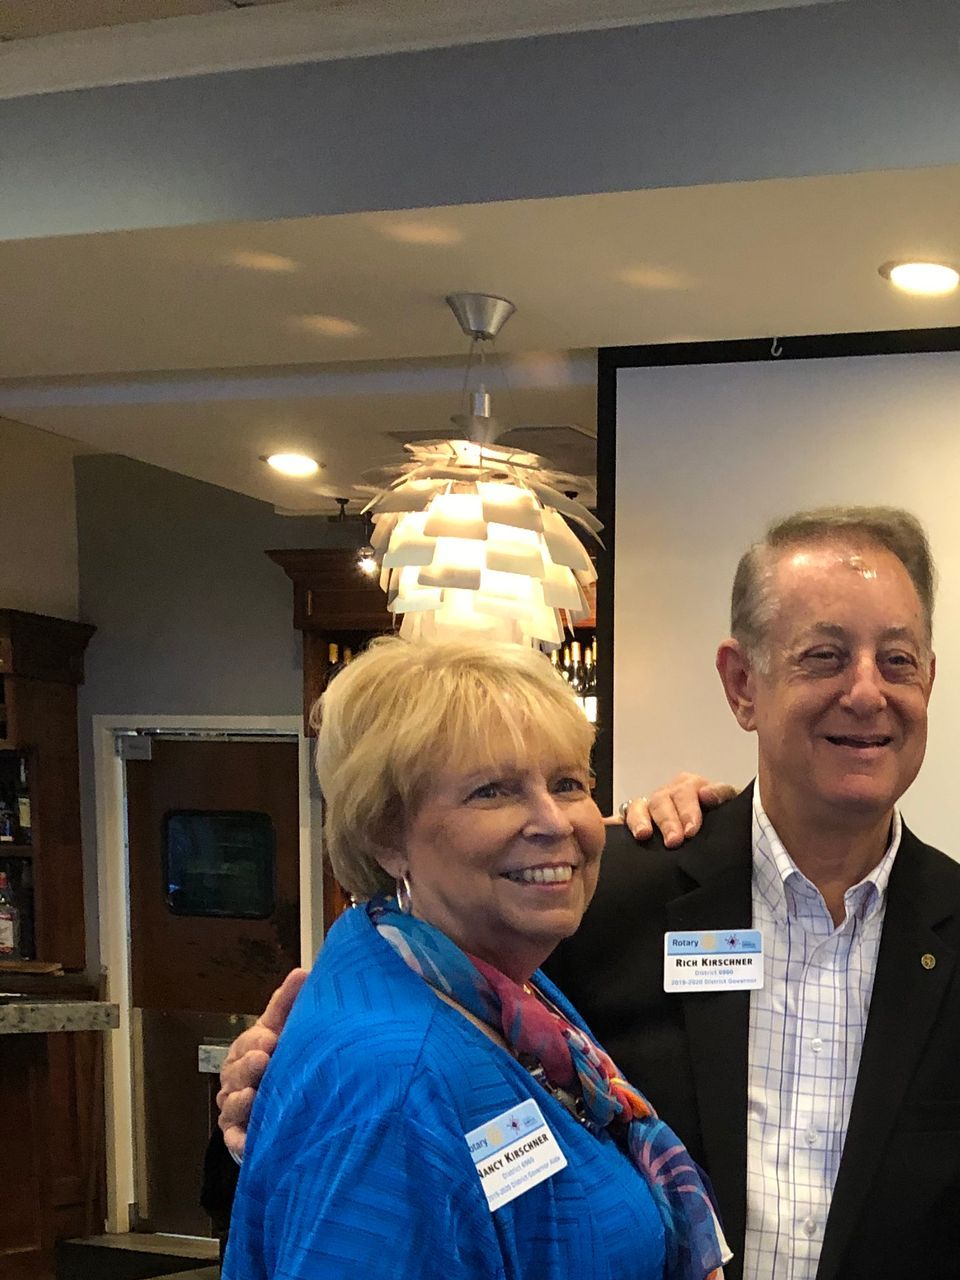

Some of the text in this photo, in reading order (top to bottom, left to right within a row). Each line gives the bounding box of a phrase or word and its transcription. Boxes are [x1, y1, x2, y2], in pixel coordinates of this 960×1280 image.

[672, 938, 699, 947] Rotary
[676, 957, 753, 967] RICH KIRSCHNER
[469, 1137, 488, 1153] otary
[504, 1133, 549, 1163] KIRSCHNER
